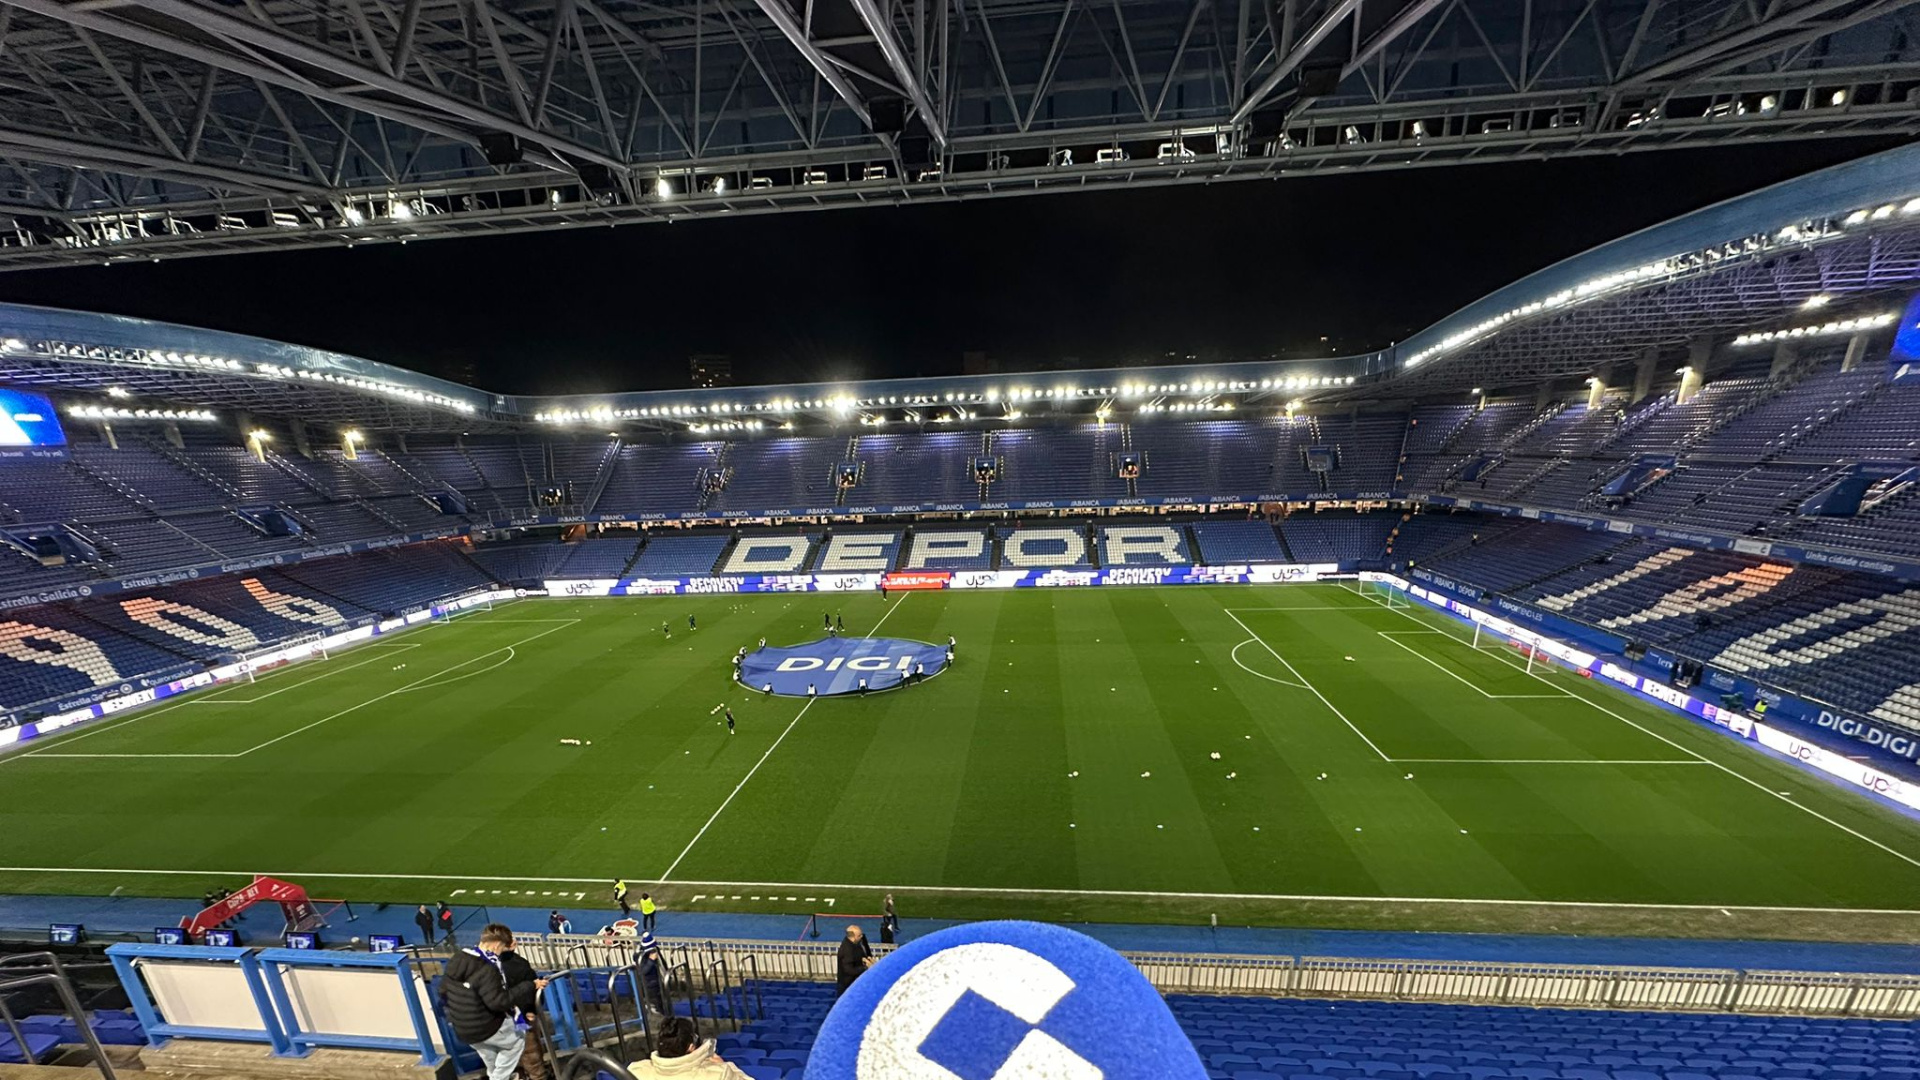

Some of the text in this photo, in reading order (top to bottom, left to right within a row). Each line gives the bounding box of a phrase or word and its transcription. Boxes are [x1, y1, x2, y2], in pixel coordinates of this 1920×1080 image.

[723, 526, 1186, 573] DEPOR
[1805, 551, 1894, 573] Unha cidade contigo
[0, 589, 78, 609] strella Galicia
[775, 656, 913, 671] DIGI
[58, 696, 91, 711] Estrella
[1817, 711, 1917, 758] DIGI DIGI
